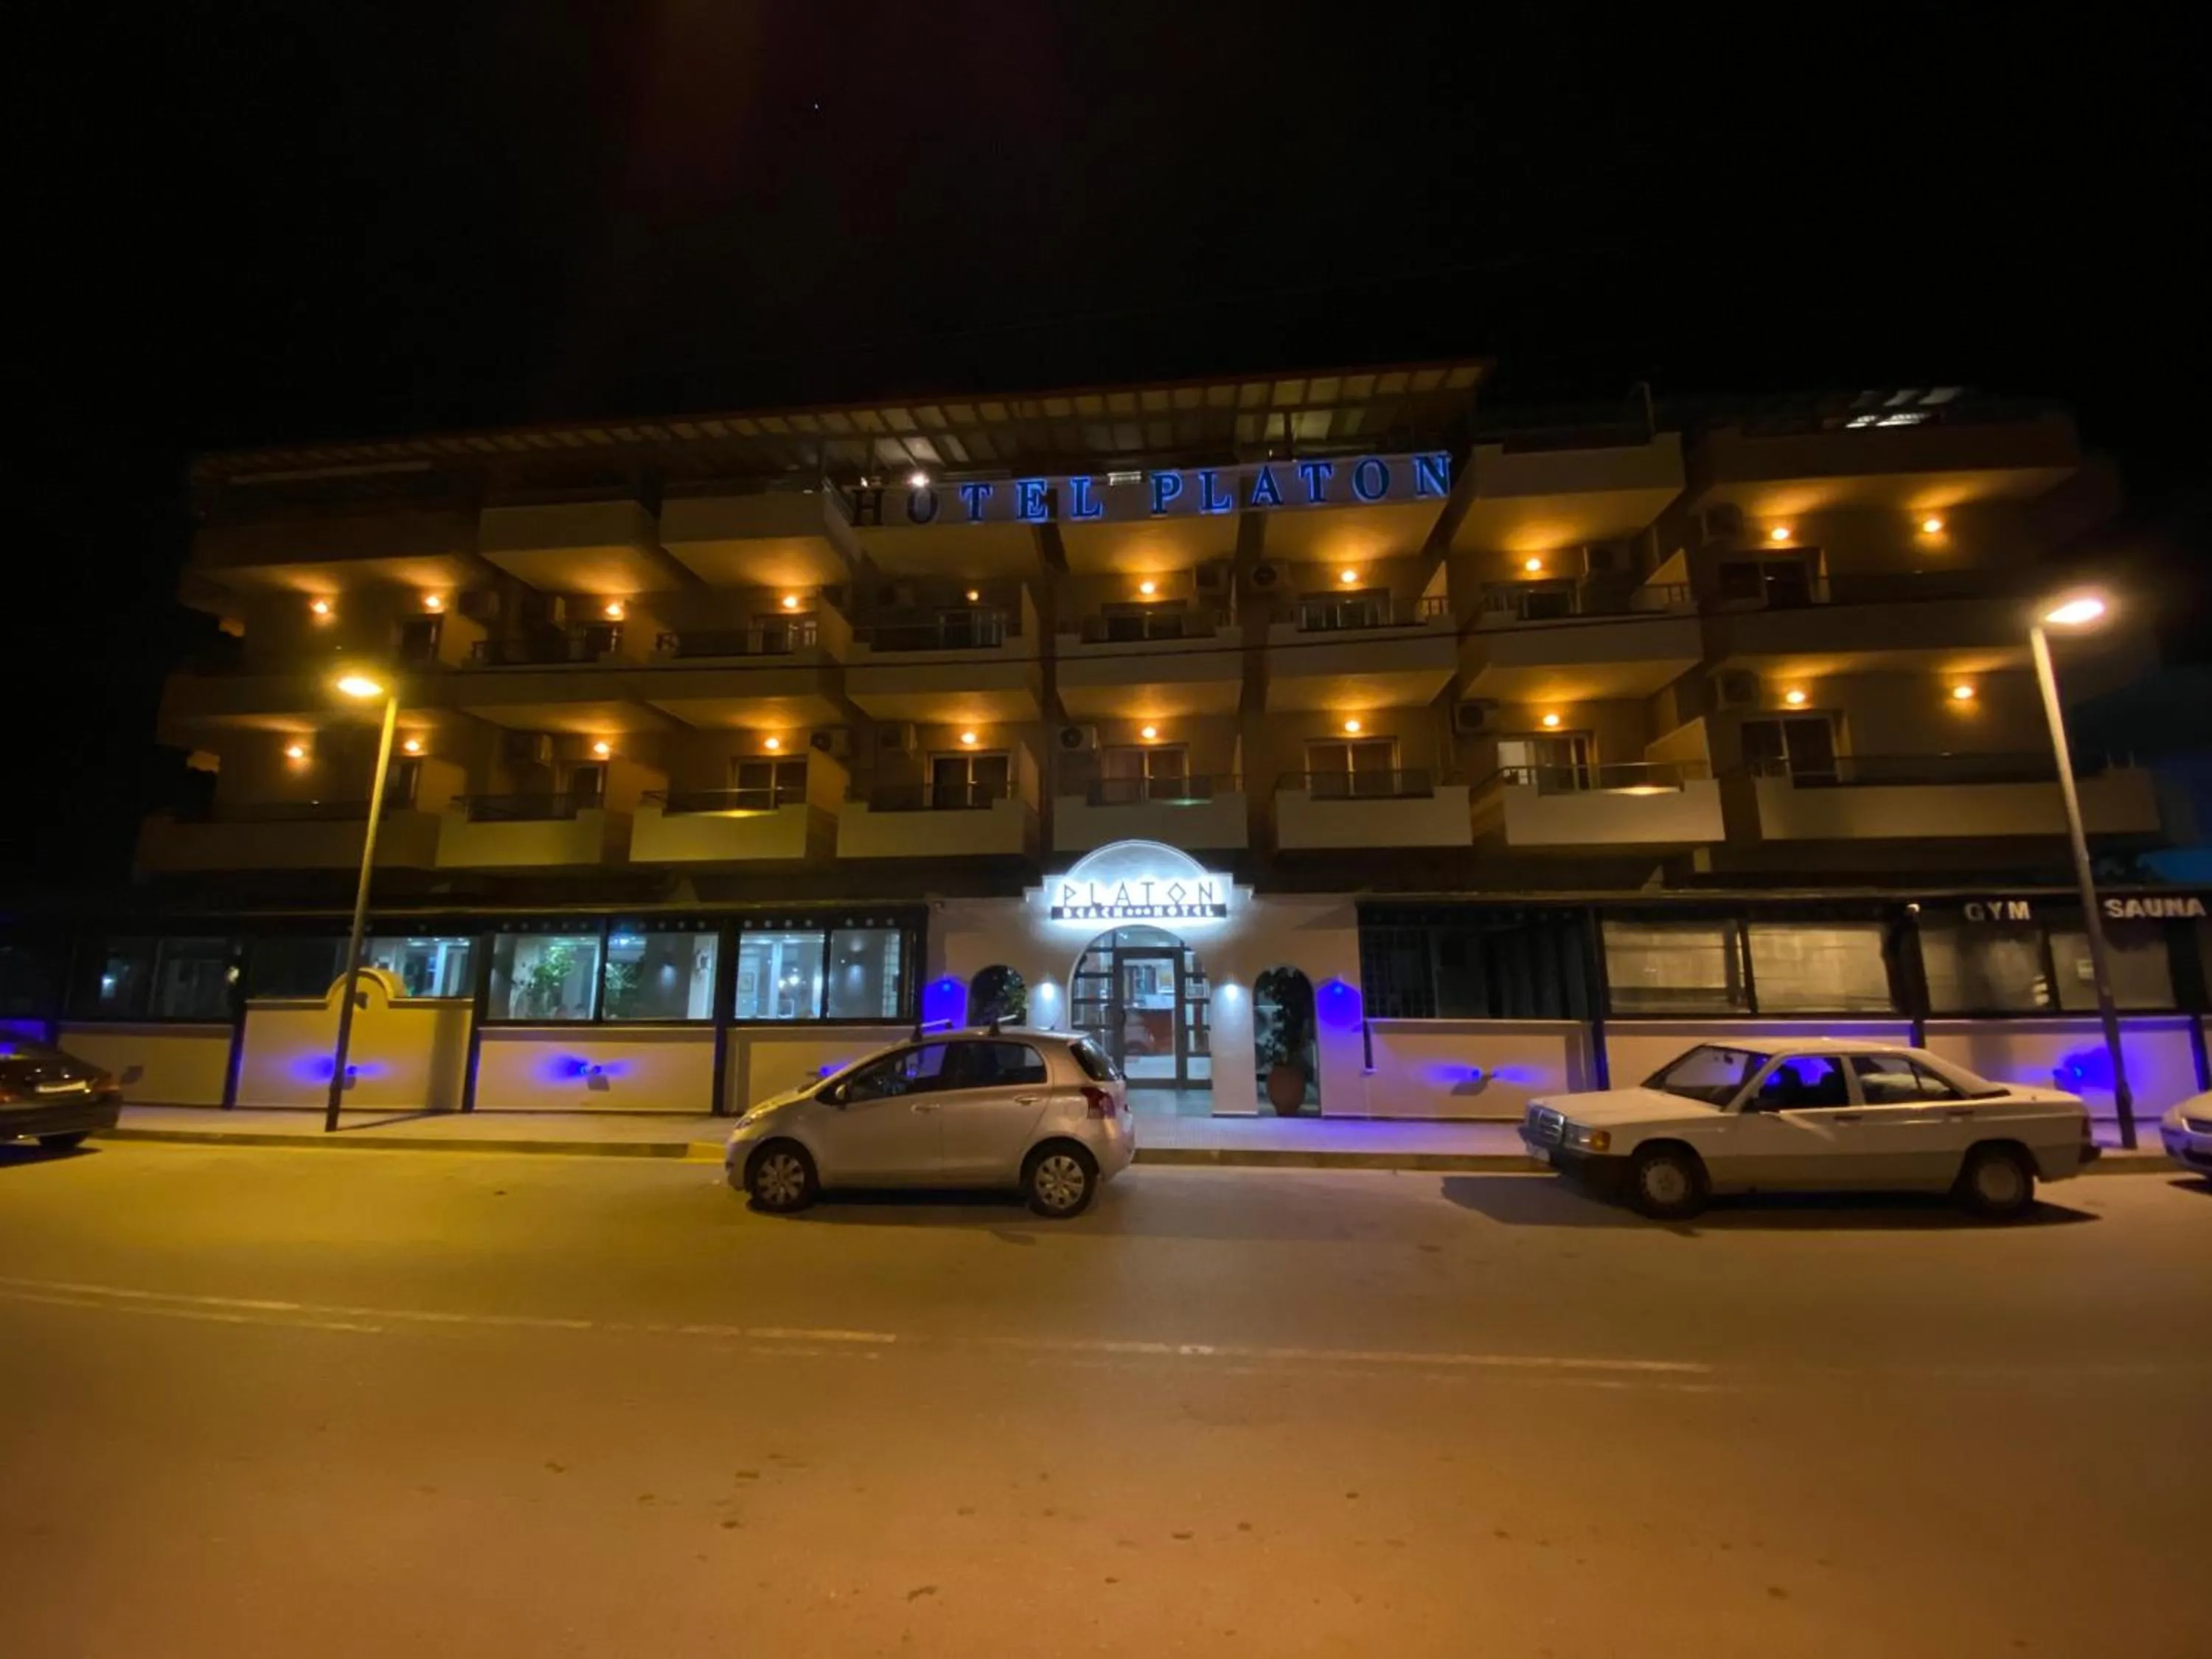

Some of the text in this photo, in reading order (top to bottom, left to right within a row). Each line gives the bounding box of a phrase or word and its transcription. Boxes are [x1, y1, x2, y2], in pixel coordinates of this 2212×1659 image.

[850, 453, 1452, 526] HOTEL PLATON
[1062, 881, 1214, 906] PLATON
[1062, 905, 1214, 919] BEACH HOTEL
[1963, 900, 2031, 921] GYM
[2104, 897, 2206, 919] SAUNA
